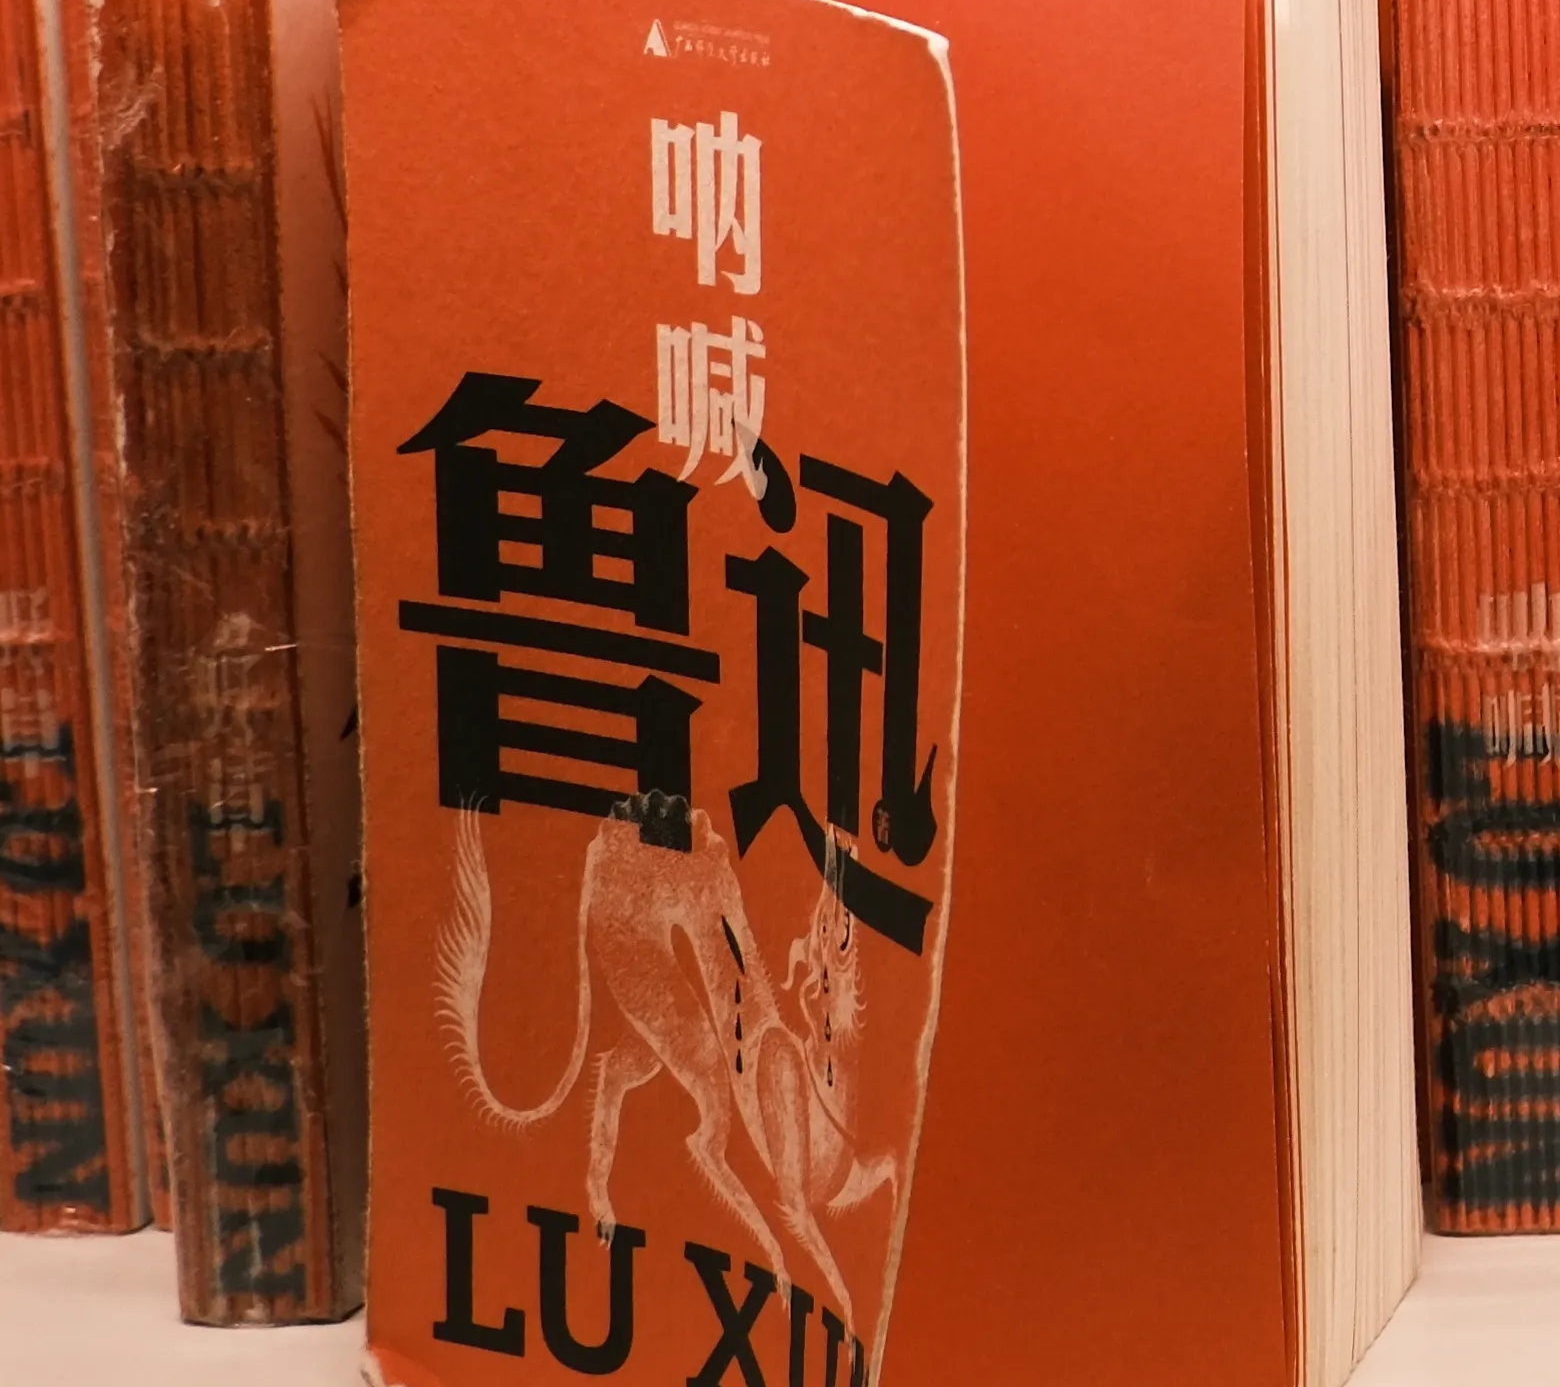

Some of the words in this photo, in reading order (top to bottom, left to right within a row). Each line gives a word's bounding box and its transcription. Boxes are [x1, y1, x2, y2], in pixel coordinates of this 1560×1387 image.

[649, 109, 770, 502] 呐喊
[397, 370, 942, 957] 鲁迅
[431, 1186, 648, 1376] LU
